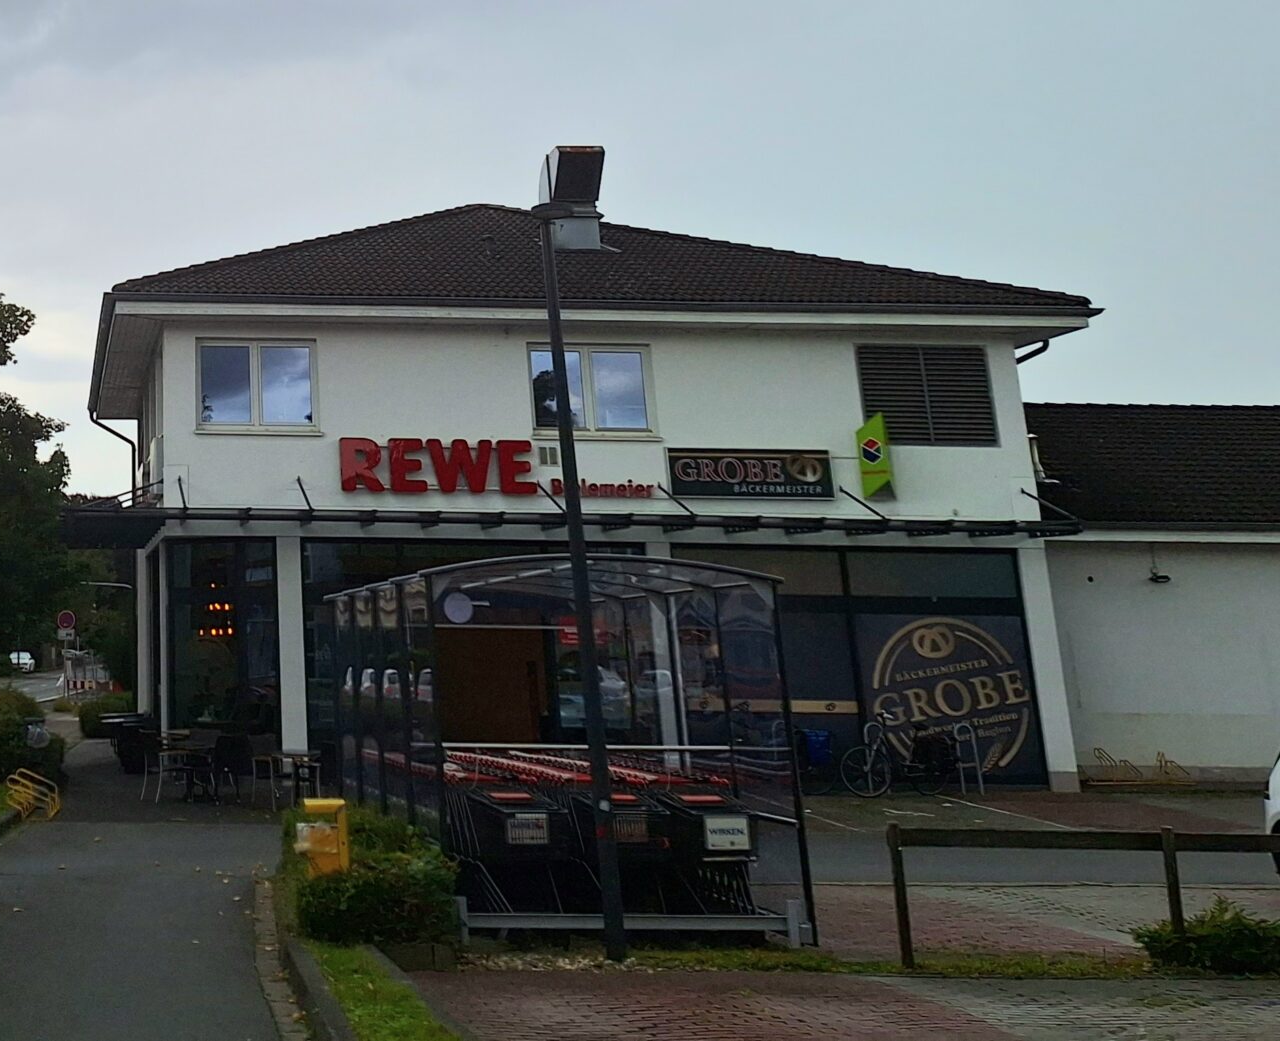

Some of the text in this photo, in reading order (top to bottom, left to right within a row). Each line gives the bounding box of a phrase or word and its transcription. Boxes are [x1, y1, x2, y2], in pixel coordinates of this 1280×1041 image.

[338, 437, 538, 496] REWE
[674, 457, 785, 484] GROBE
[733, 483, 823, 494] BÄCKERMEISTER
[895, 658, 989, 682] BÄCKERMEISTER
[873, 669, 1029, 726] GROBE
